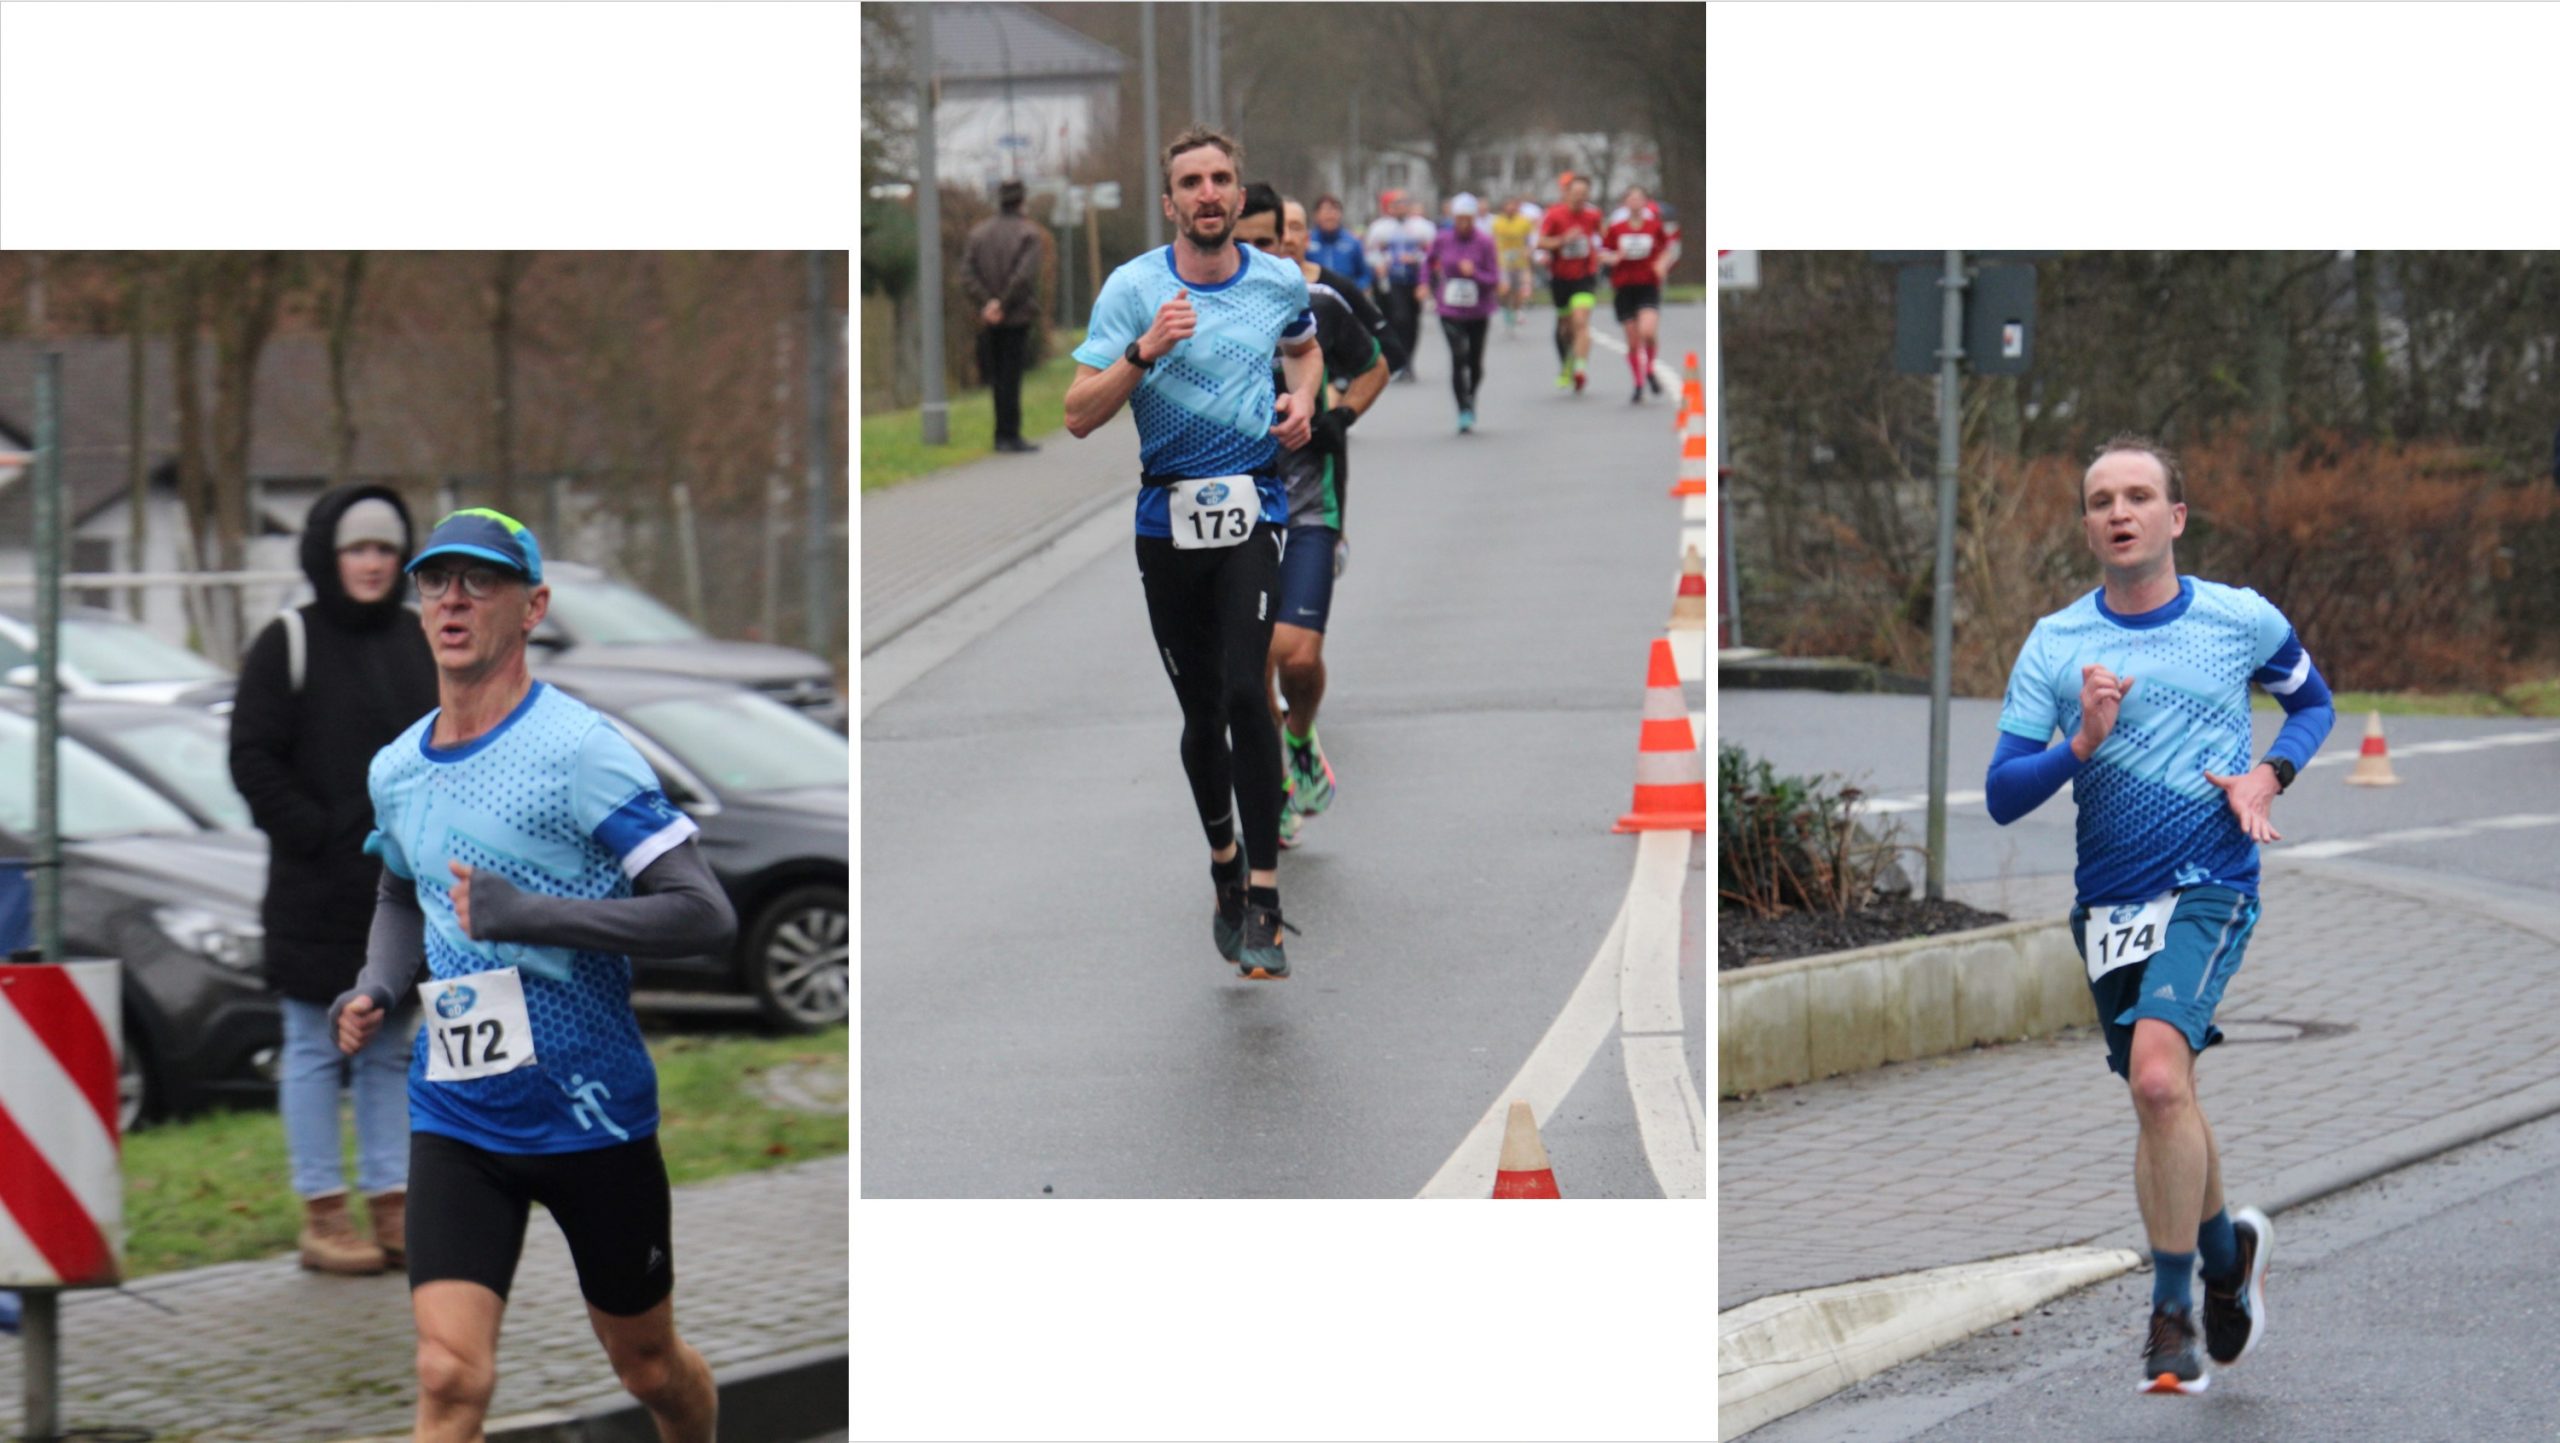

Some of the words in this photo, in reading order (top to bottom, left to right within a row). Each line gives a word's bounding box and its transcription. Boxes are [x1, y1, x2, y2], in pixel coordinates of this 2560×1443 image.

[1188, 507, 1249, 540] 173
[2098, 923, 2155, 965] 174
[438, 1019, 509, 1068] 172
